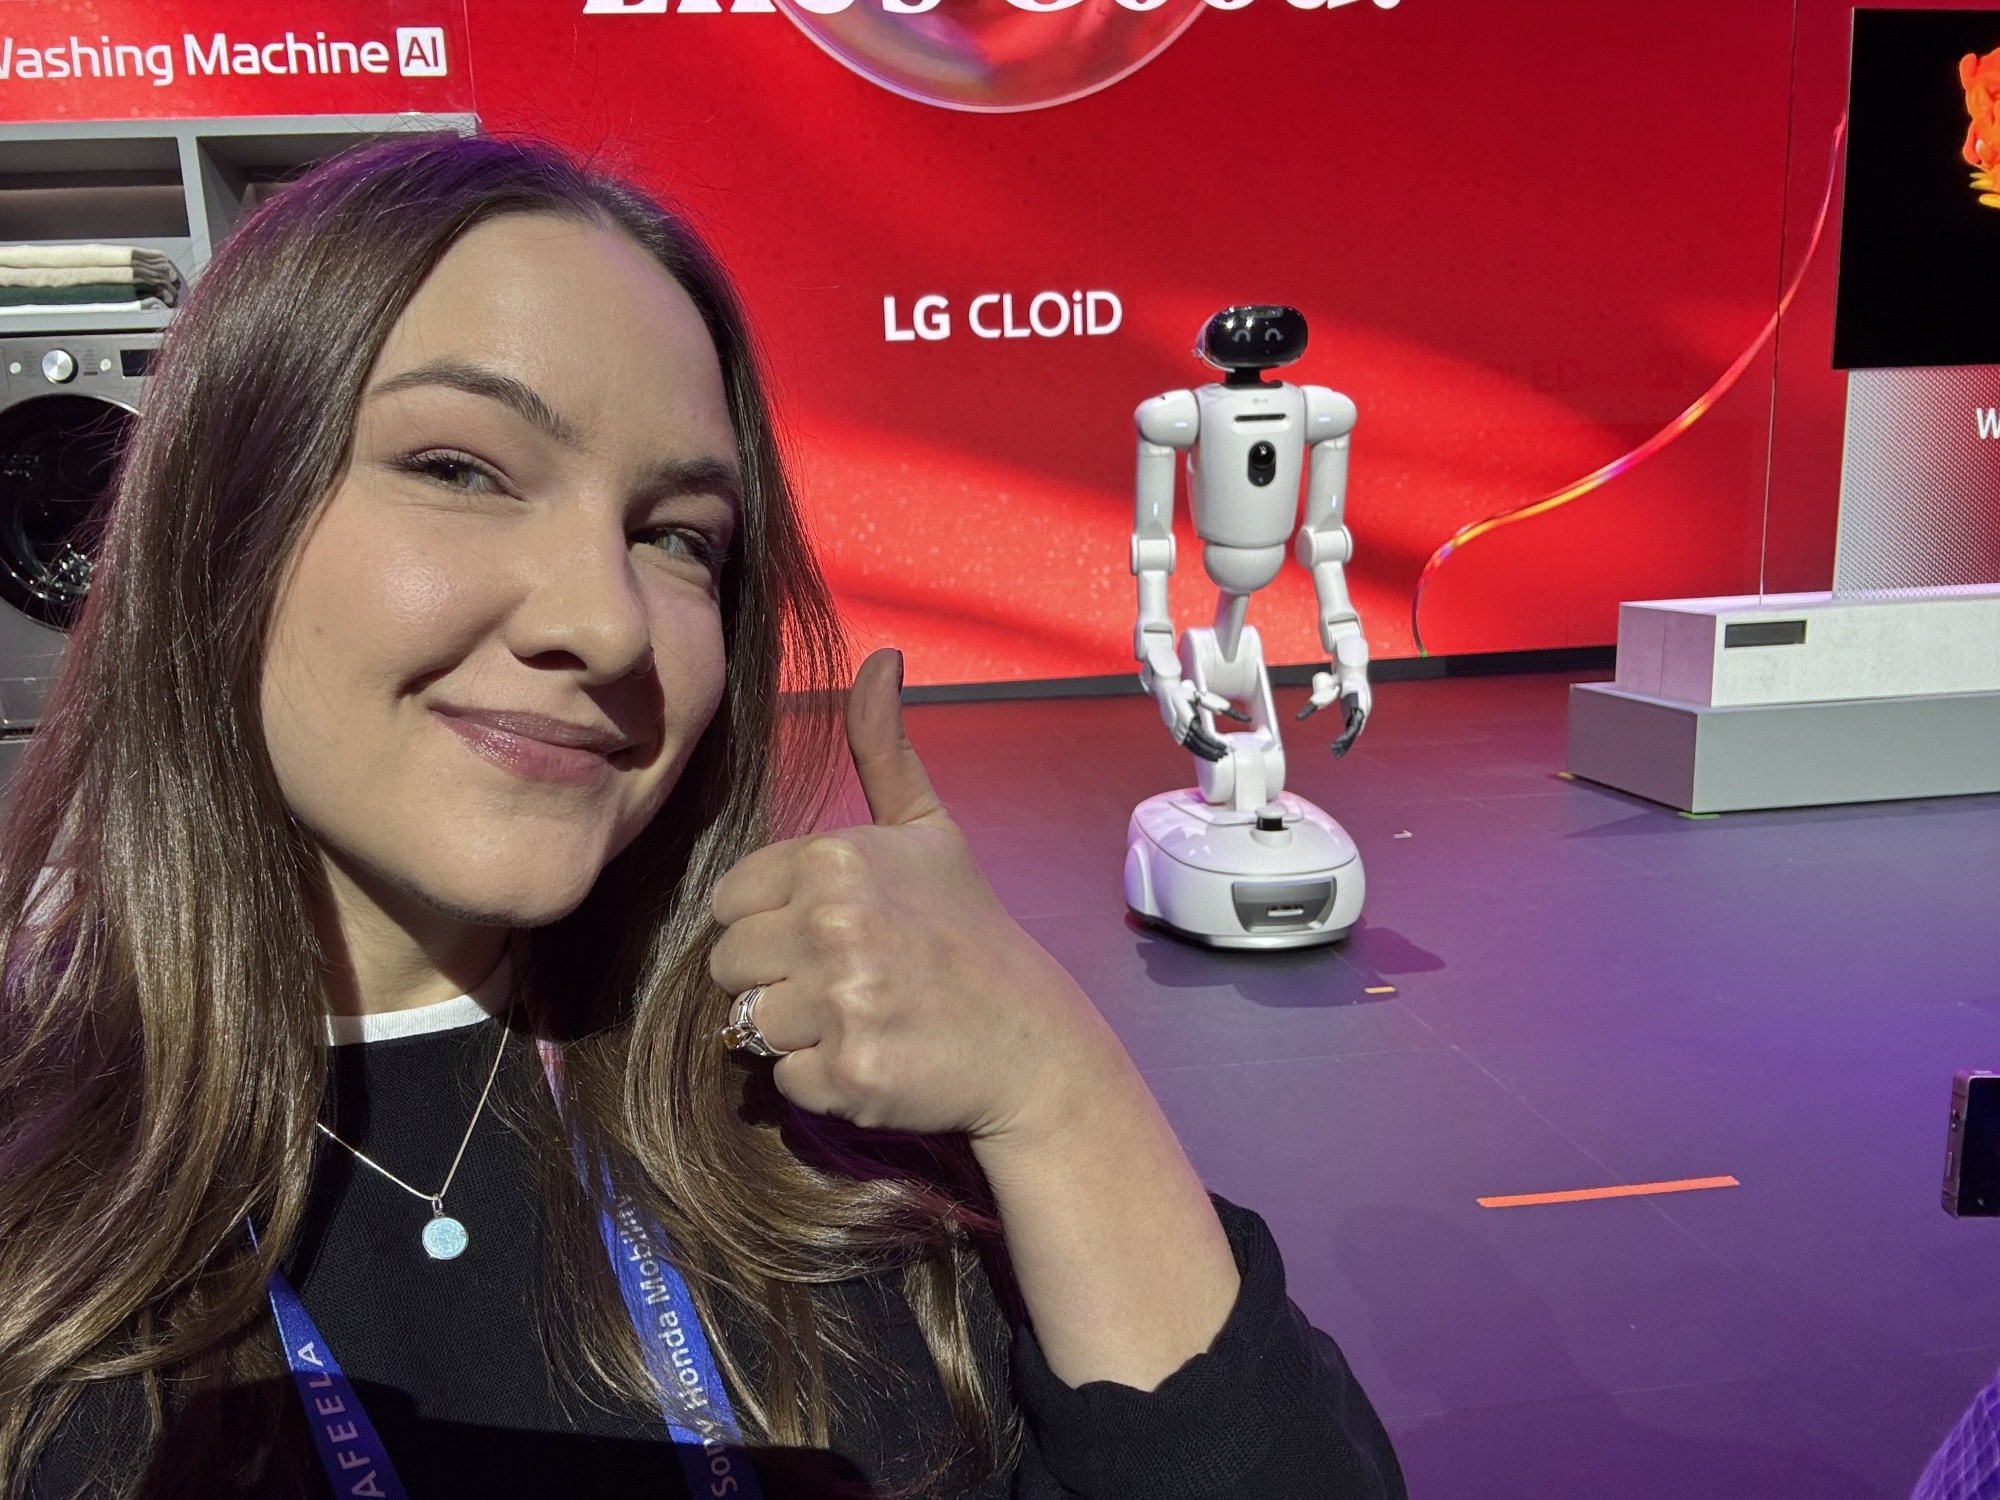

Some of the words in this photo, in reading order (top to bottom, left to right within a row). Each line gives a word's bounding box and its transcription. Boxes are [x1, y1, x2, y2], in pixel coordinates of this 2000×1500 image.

[0, 35, 174, 87] ashing
[183, 31, 390, 75] Machine
[403, 36, 439, 67] AI
[884, 295, 950, 341] LG
[968, 290, 1123, 338] CLOiD
[658, 1310, 708, 1410] Honda
[297, 1341, 386, 1498] AFEELA
